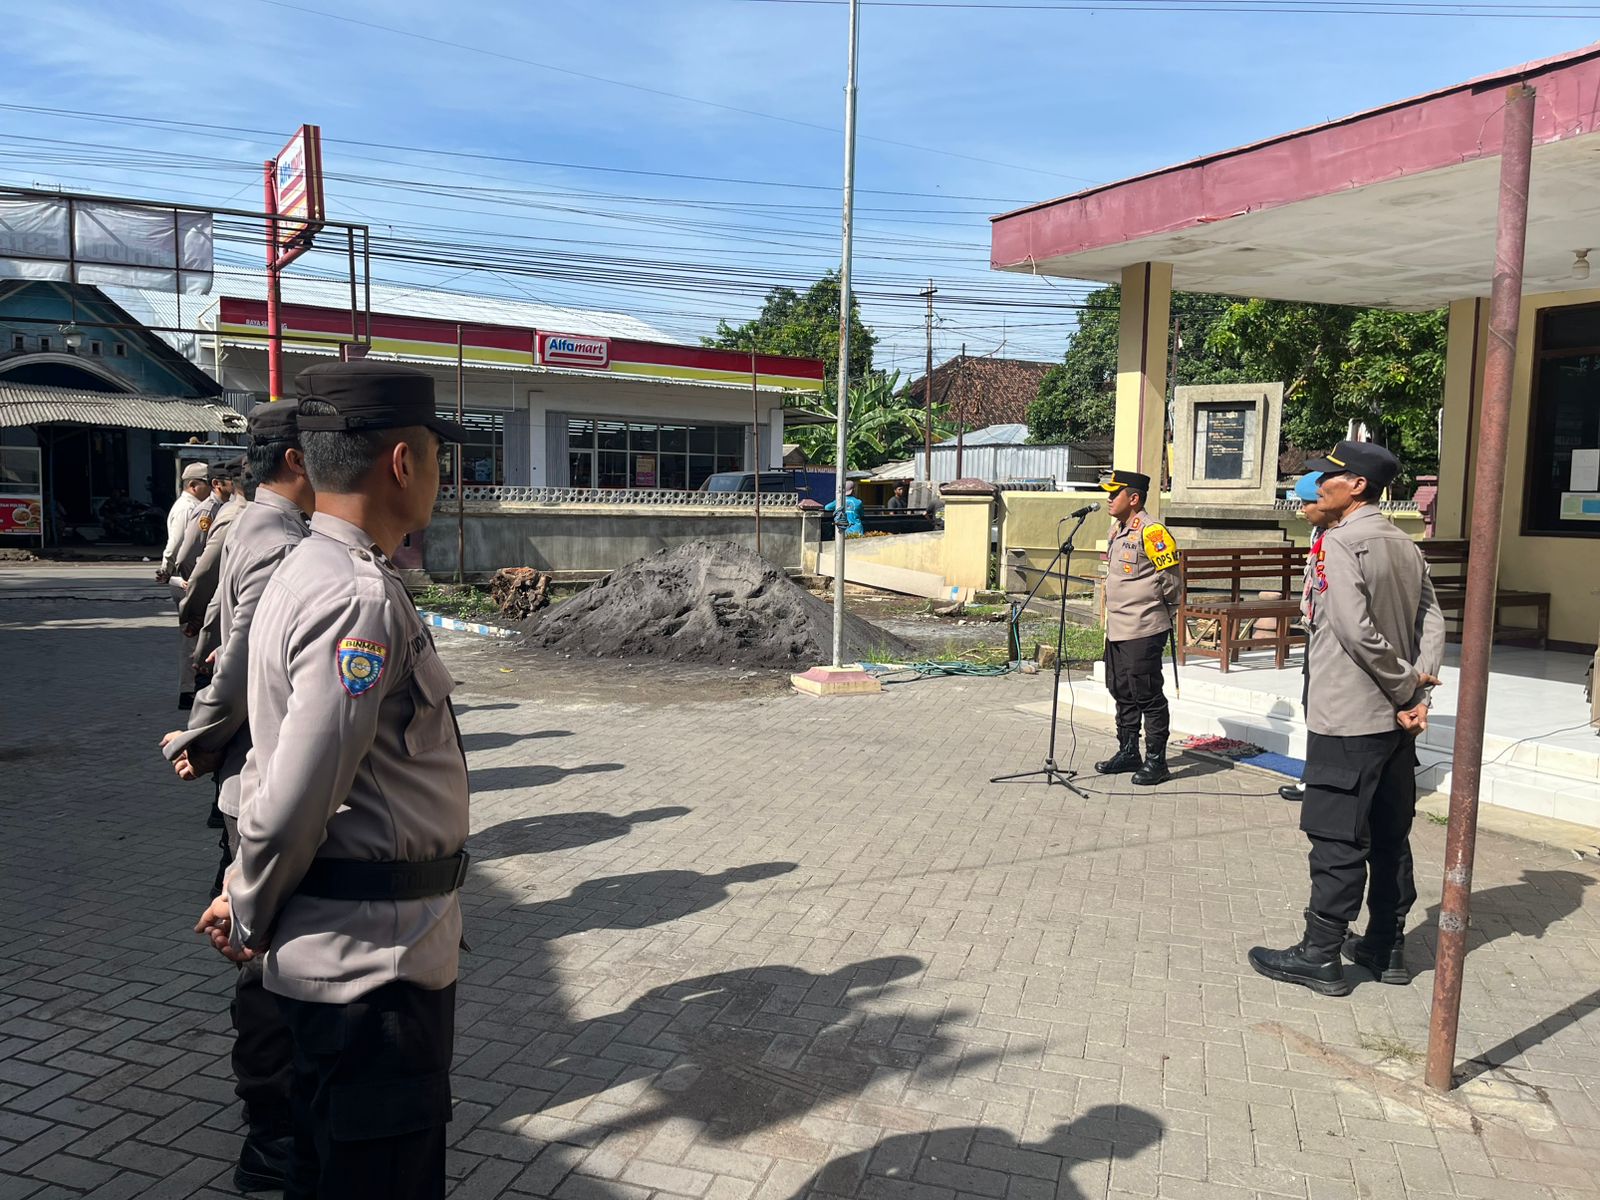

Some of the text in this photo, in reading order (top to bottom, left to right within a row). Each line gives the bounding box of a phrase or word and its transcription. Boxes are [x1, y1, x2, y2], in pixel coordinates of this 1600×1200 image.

[549, 338, 604, 354] Alfamart
[1122, 542, 1137, 550] POLRI
[1155, 552, 1173, 567] OPS
[345, 640, 382, 653] BINMAS
